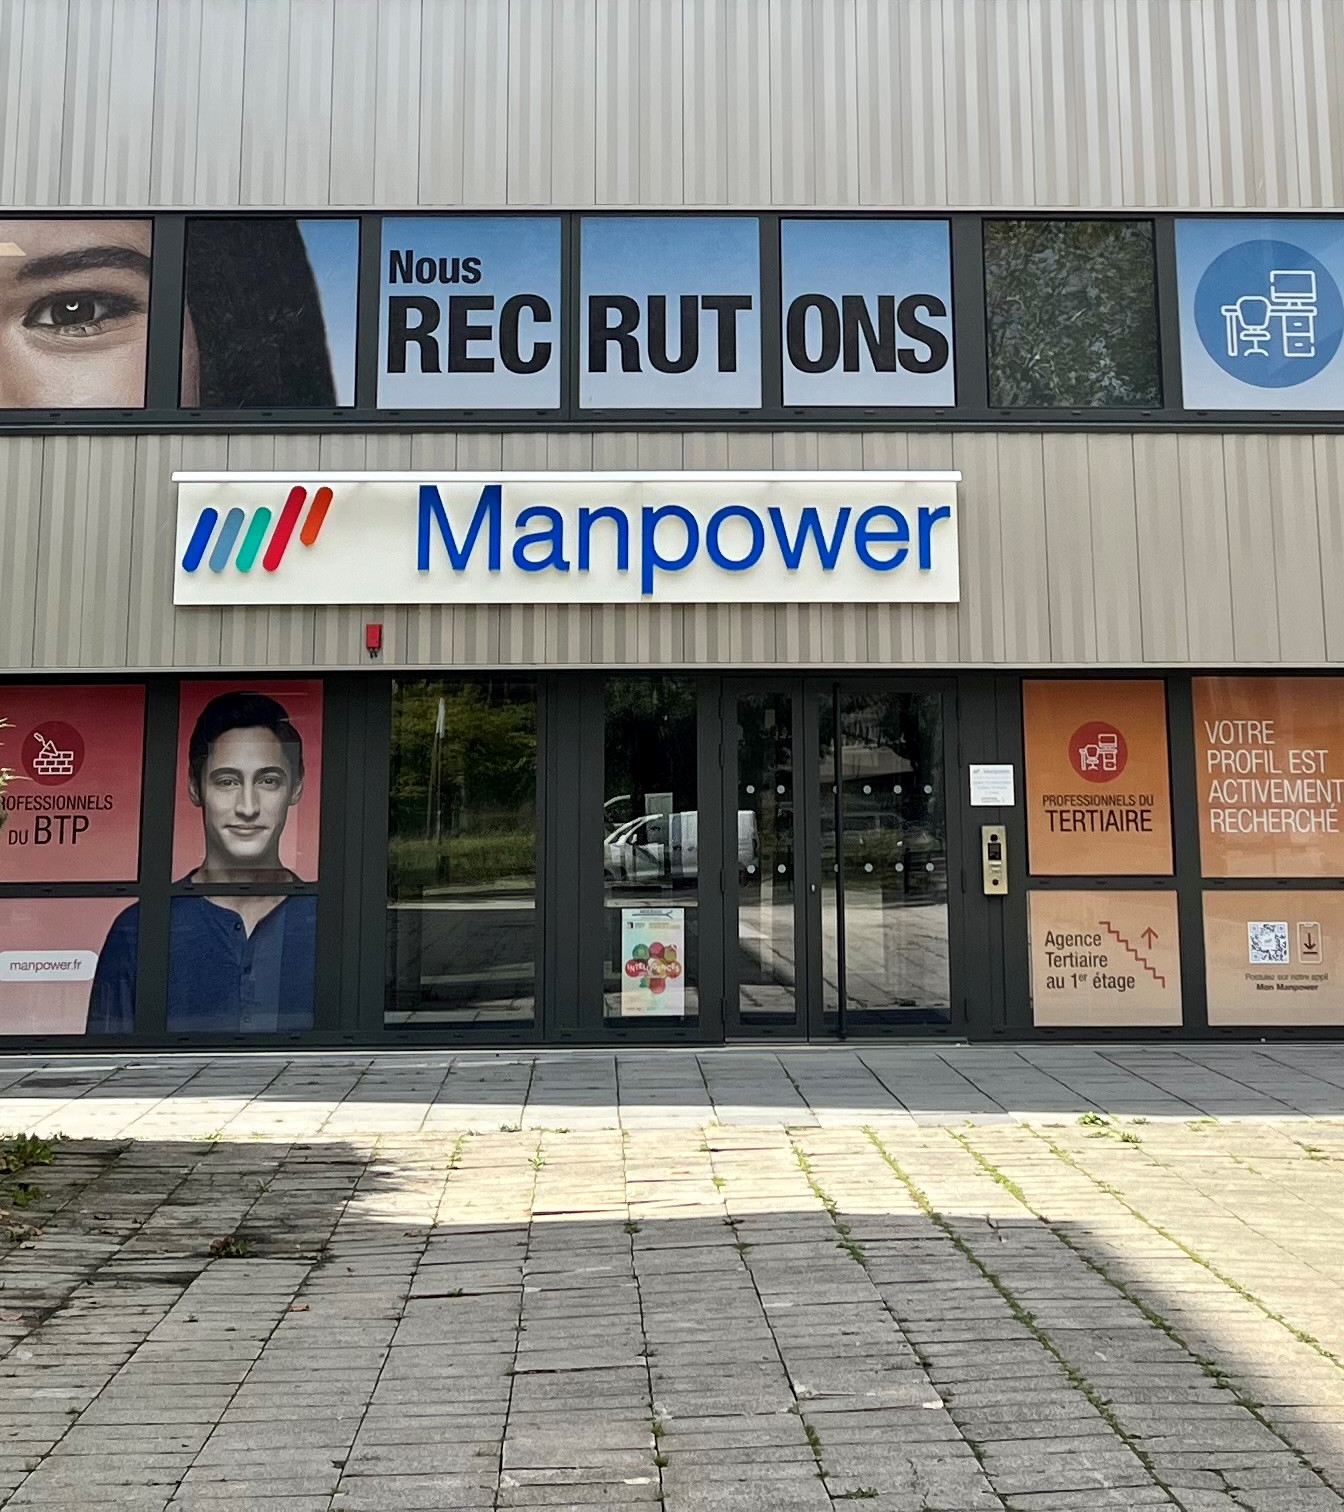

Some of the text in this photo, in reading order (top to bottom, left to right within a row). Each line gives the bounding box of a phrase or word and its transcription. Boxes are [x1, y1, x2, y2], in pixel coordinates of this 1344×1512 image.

[389, 250, 481, 284] Nous
[387, 294, 950, 374] REC RUT ONS
[417, 485, 951, 595] Manpower
[1204, 720, 1276, 744] VOTRE
[1207, 749, 1329, 774] PROFIL EST
[1043, 794, 1154, 807] PROFESSIONNELS DU
[1208, 778, 1344, 804] ACTIVEMENT
[1045, 809, 1153, 832] TERTIAIRE
[1210, 802, 1339, 833] RECHERCHÉ
[8, 815, 89, 845] DU BTP
[1044, 931, 1102, 950] Agence
[9, 959, 82, 973] manpower.fr
[1045, 951, 1108, 968] Tertiaire
[1046, 976, 1065, 989] au
[1092, 972, 1136, 992] étage
[1276, 984, 1319, 992] Manpower
